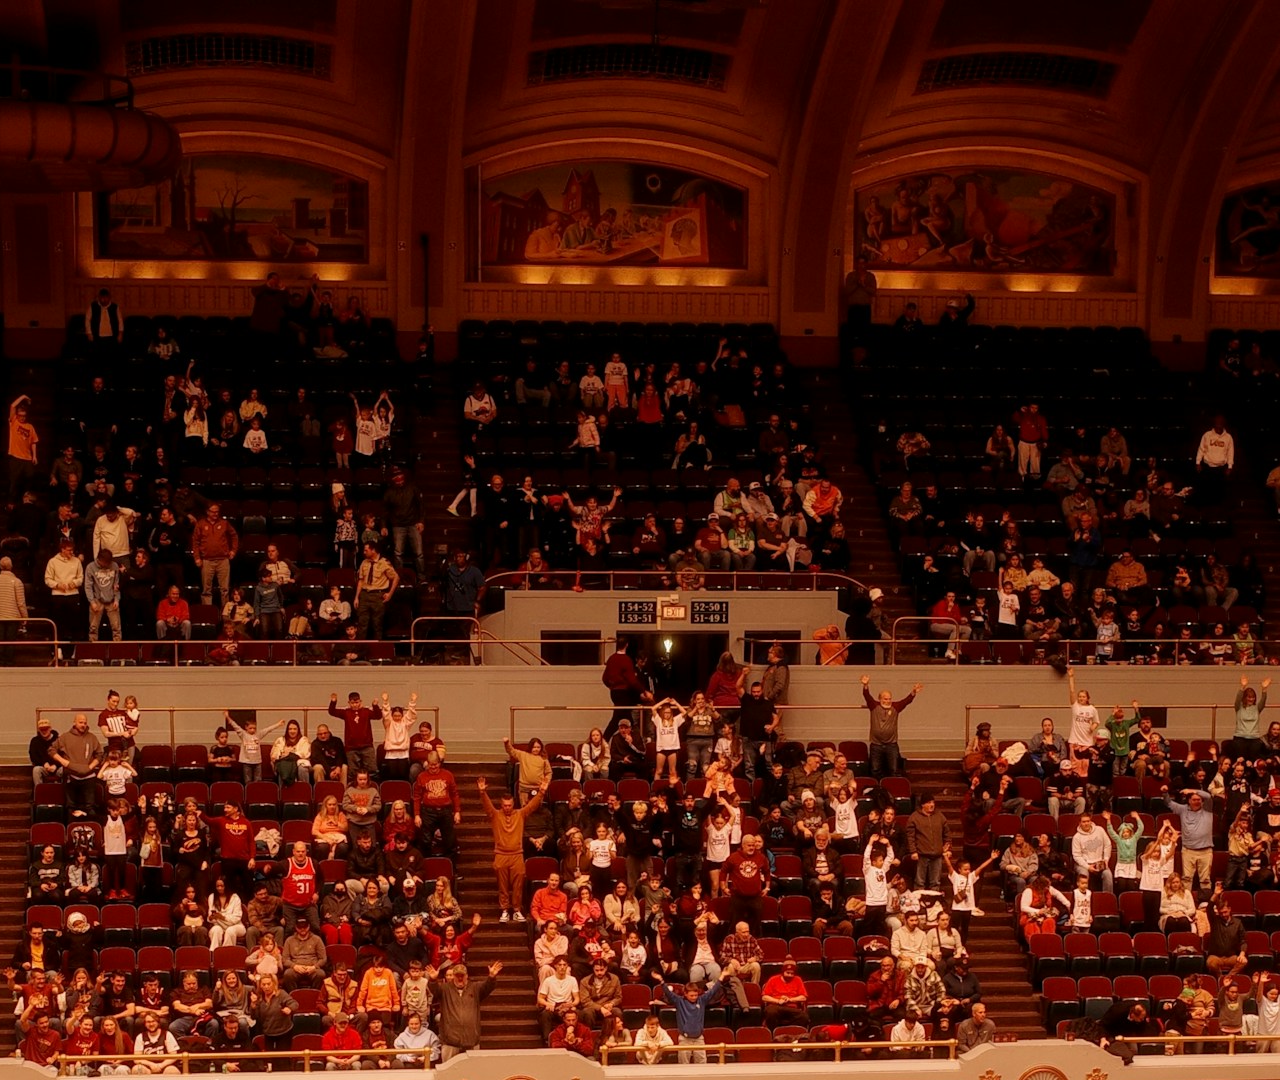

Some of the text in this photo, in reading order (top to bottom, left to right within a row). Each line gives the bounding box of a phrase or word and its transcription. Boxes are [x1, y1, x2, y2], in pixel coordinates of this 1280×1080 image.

[626, 603, 654, 611] 54-52
[693, 603, 721, 611] 52-50
[666, 608, 682, 617] EXIT
[626, 614, 653, 623] 53-51
[693, 614, 721, 623] 51-49
[296, 882, 310, 894] 31
